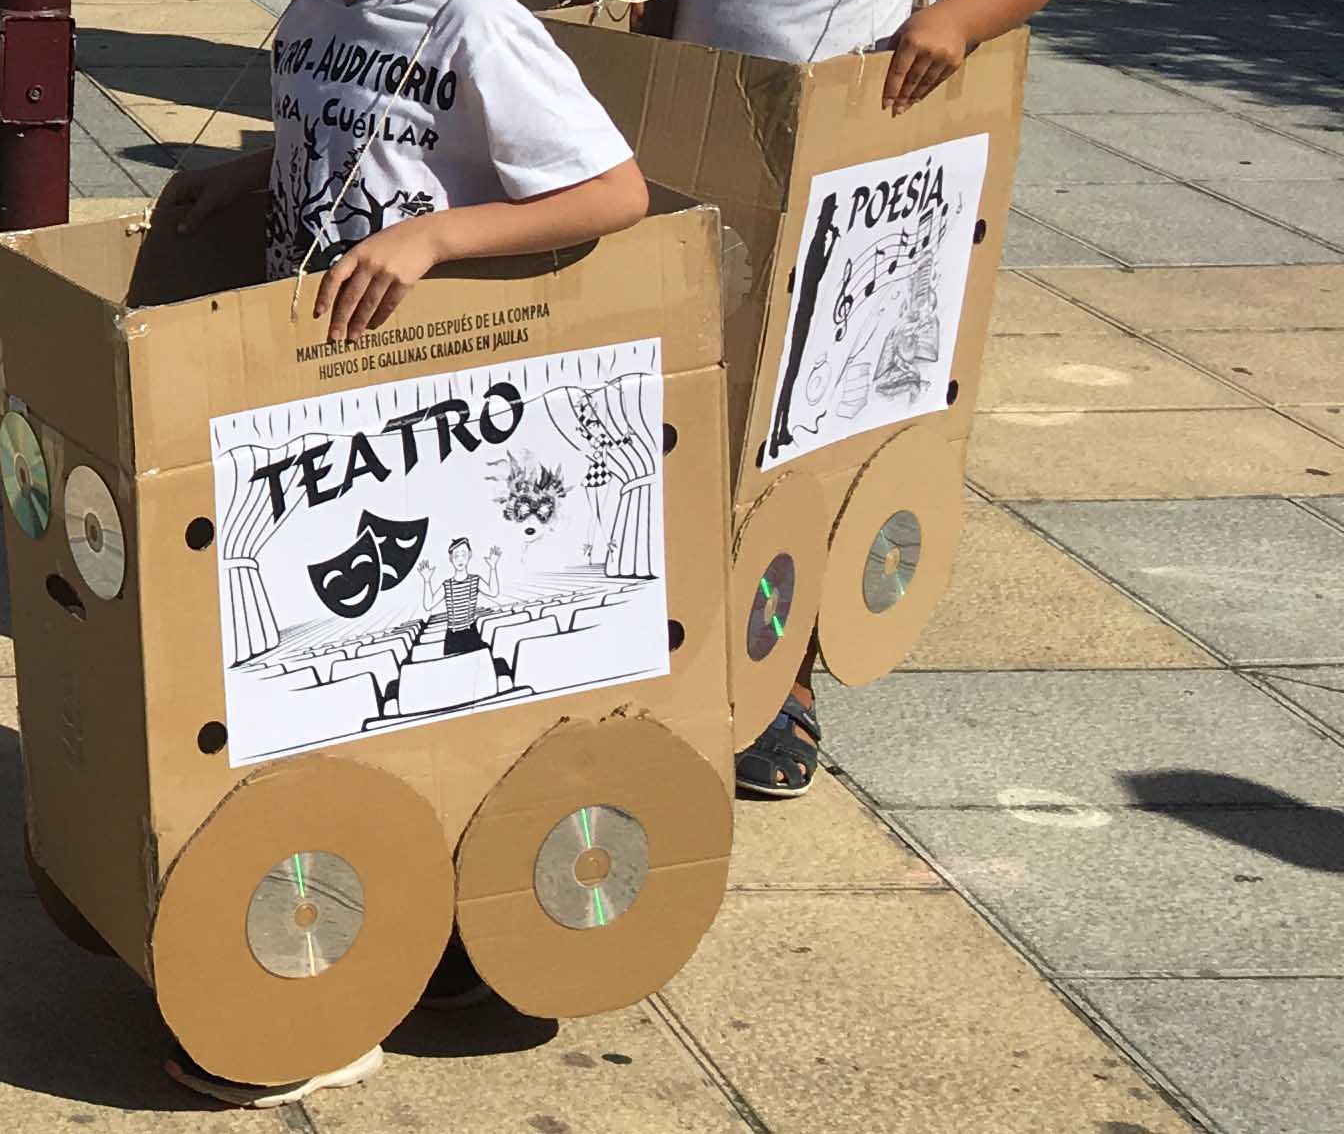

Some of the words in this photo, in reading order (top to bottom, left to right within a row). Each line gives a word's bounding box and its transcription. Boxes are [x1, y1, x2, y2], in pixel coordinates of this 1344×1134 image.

[847, 155, 944, 233] POESÍA
[296, 340, 351, 362] MANTENER
[353, 325, 424, 352] REFRIGERADO
[427, 315, 473, 338] DESPUÉS
[476, 312, 490, 329] DE
[492, 310, 506, 327] LA
[507, 302, 550, 323] COMPRA
[319, 360, 359, 380] HUEVOS
[362, 356, 376, 371] DE
[378, 347, 428, 368] GALLINAS
[430, 339, 474, 359] CRIADAS
[476, 335, 490, 351] EN
[492, 328, 529, 351] JAULAS
[249, 381, 525, 524] TEATRO
